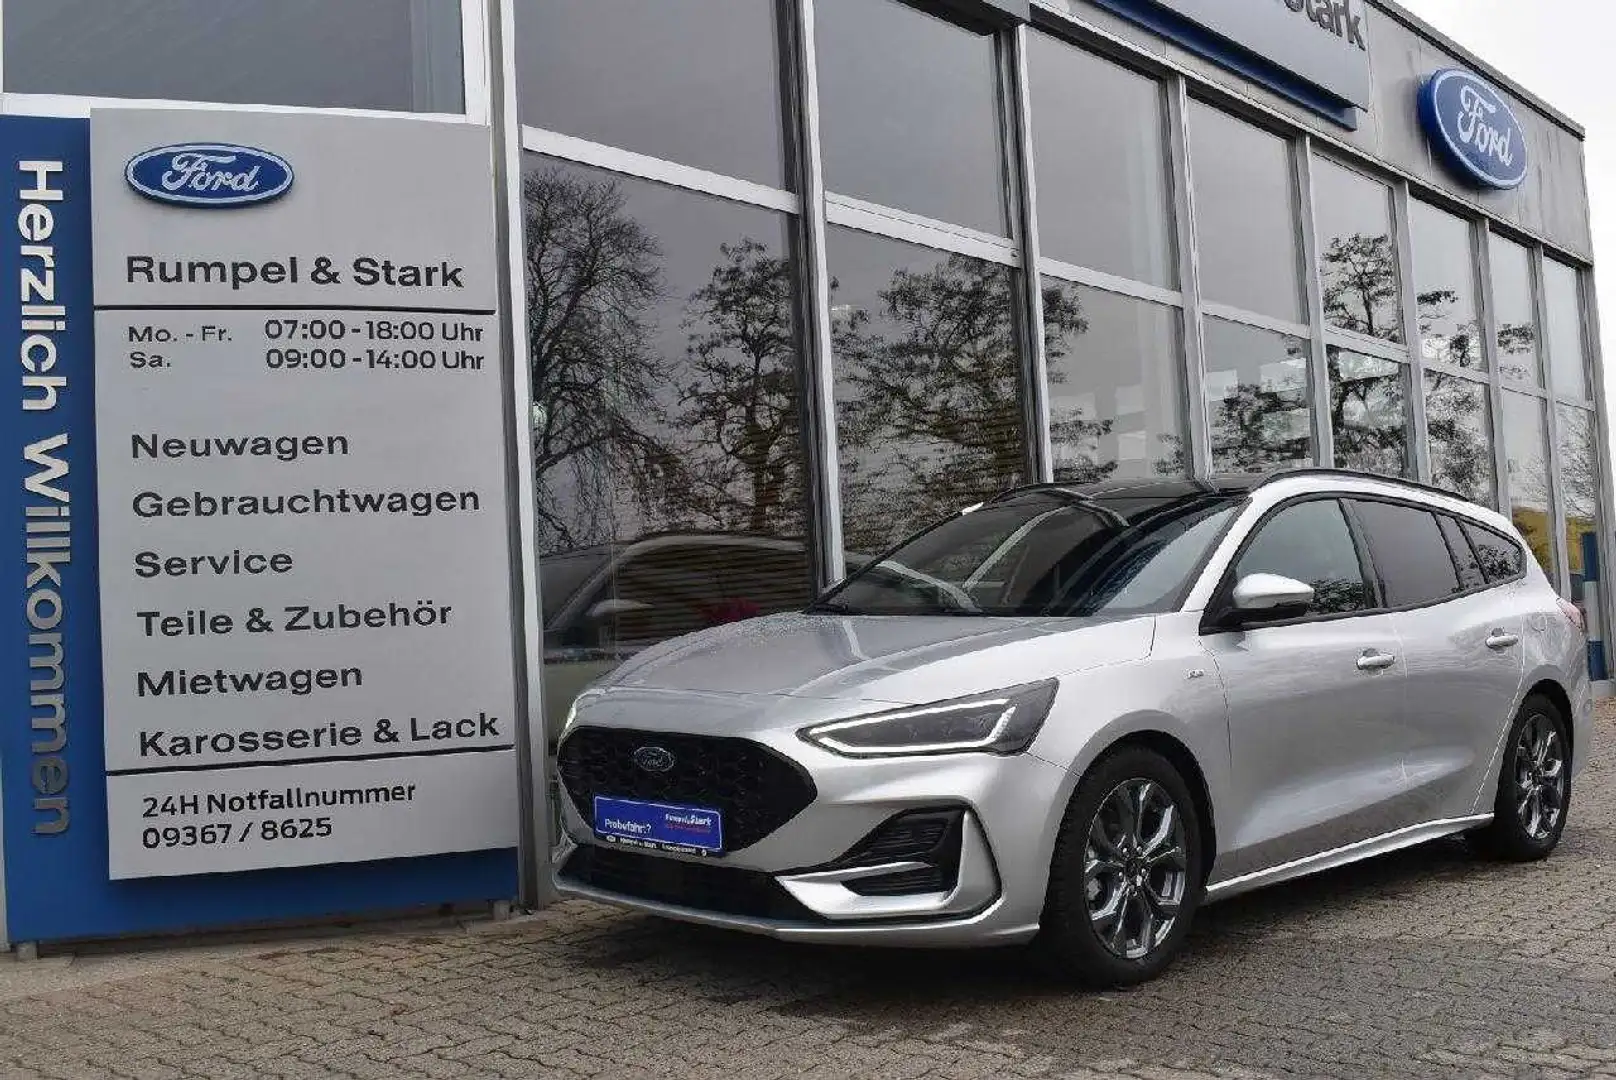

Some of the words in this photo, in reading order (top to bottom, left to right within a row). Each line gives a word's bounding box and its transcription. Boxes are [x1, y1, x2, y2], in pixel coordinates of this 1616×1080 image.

[1457, 85, 1513, 166] Ford
[162, 152, 261, 191] Ford
[18, 160, 67, 410] Herzlich
[127, 256, 298, 290] Rumpel
[310, 257, 341, 286] &
[353, 257, 465, 288] Stark
[128, 326, 178, 342] Mo.
[201, 326, 233, 342] Fr.
[441, 323, 484, 342] Uhr
[130, 351, 171, 369] Sa.
[442, 350, 485, 370] Uhr
[131, 434, 349, 462] Neuwagen
[132, 488, 480, 518] Gebrauchtwagen
[134, 549, 293, 579] Service
[24, 432, 71, 834] Willkommen
[137, 609, 234, 637] Teile
[245, 608, 274, 633] &
[284, 600, 452, 632] Zubehör
[137, 666, 363, 698] Mietwagen
[139, 723, 362, 758] Karosserie
[373, 718, 400, 743] &
[410, 713, 500, 741] Lack
[142, 795, 199, 818] 24H
[206, 785, 416, 814] Notfallnummer
[142, 824, 233, 849] 09367
[238, 821, 254, 843] /
[260, 817, 332, 841] 8625
